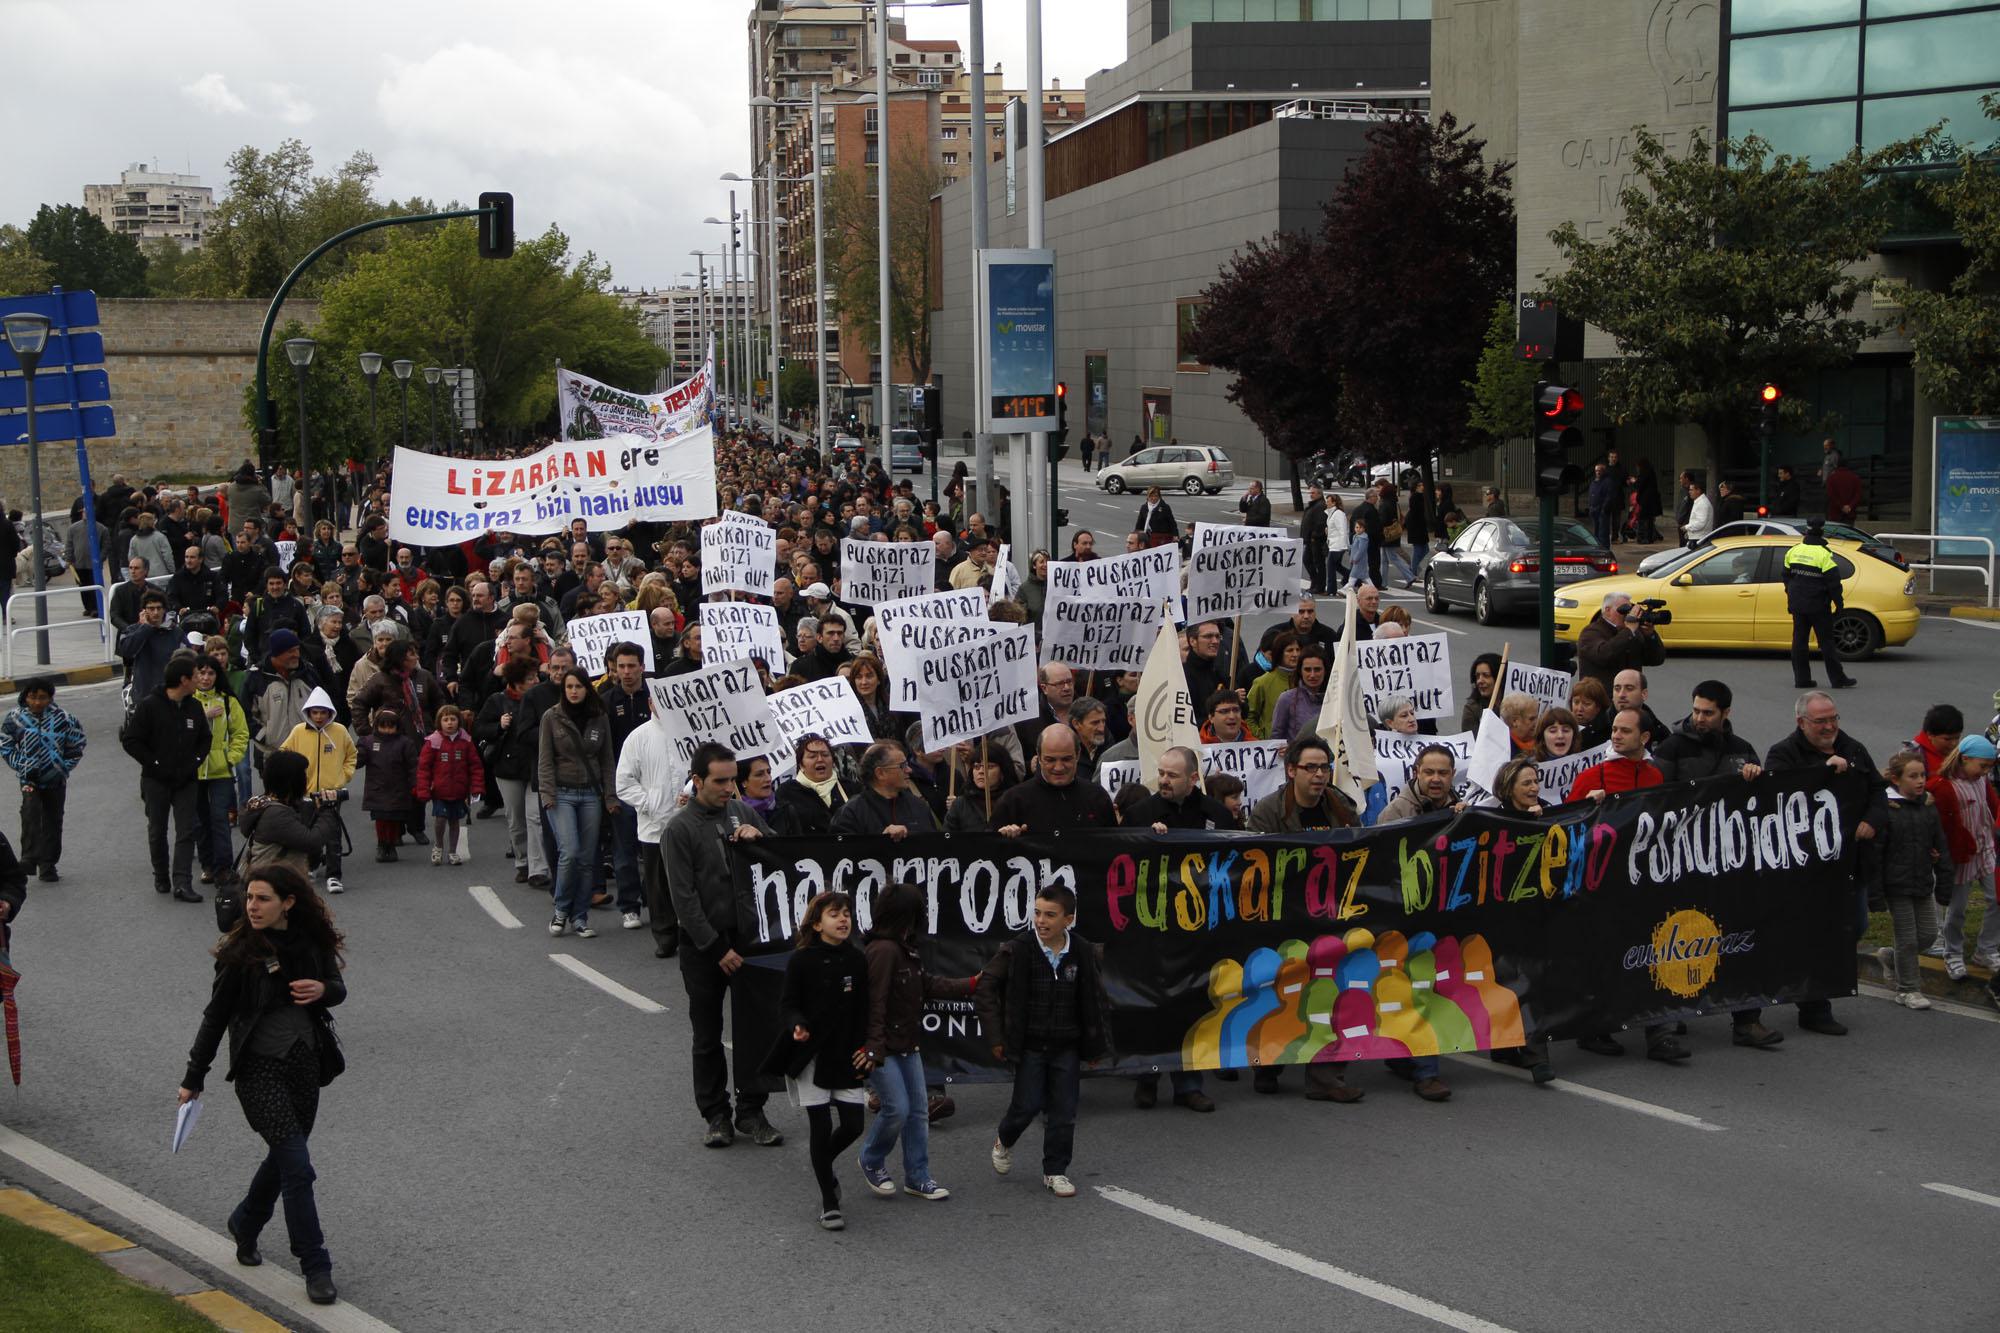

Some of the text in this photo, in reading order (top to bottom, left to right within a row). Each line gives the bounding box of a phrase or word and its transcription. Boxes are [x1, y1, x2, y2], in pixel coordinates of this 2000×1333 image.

[913, 388, 924, 403] P
[620, 447, 660, 471] ere
[1970, 487, 2000, 495] movis
[406, 484, 684, 531] euskaraz bizi nahi dugu
[703, 526, 772, 551] euskaraz
[720, 546, 751, 566] bizi
[847, 543, 930, 566] euskaraz
[1196, 545, 1297, 573] euskaraz
[705, 565, 769, 589] nahi dut
[871, 565, 905, 584] bizi
[1086, 551, 1173, 588] euskaraz
[1225, 567, 1264, 589] bizi
[849, 581, 888, 601] nahi
[1196, 590, 1243, 616] nahi
[1254, 588, 1293, 608] dut
[700, 606, 775, 627] uskaraz
[1056, 600, 1156, 625] euskaraz
[568, 614, 643, 639] uskaraz
[714, 625, 754, 643] bizi
[1083, 623, 1121, 644] bizi
[923, 634, 1029, 686] euskaraz
[1051, 643, 1145, 666] nahi dut
[1357, 640, 1443, 668] uskaraz
[653, 665, 754, 710] euskaraz
[958, 670, 1001, 703] bizi
[1371, 668, 1413, 692] bizi
[1511, 667, 1569, 699] euskaraz
[768, 682, 847, 718] skaraz
[684, 701, 732, 733] bizi
[776, 706, 825, 735] bizi
[932, 687, 1029, 740] nahi dut
[730, 719, 770, 751] dut
[822, 715, 861, 740] dut
[1106, 845, 1369, 932] euskaraz
[1399, 822, 1617, 915] bizitzeko
[1628, 788, 1843, 886] eskubidea
[1623, 922, 1755, 970] euskaraz
[1687, 963, 1701, 985] bai
